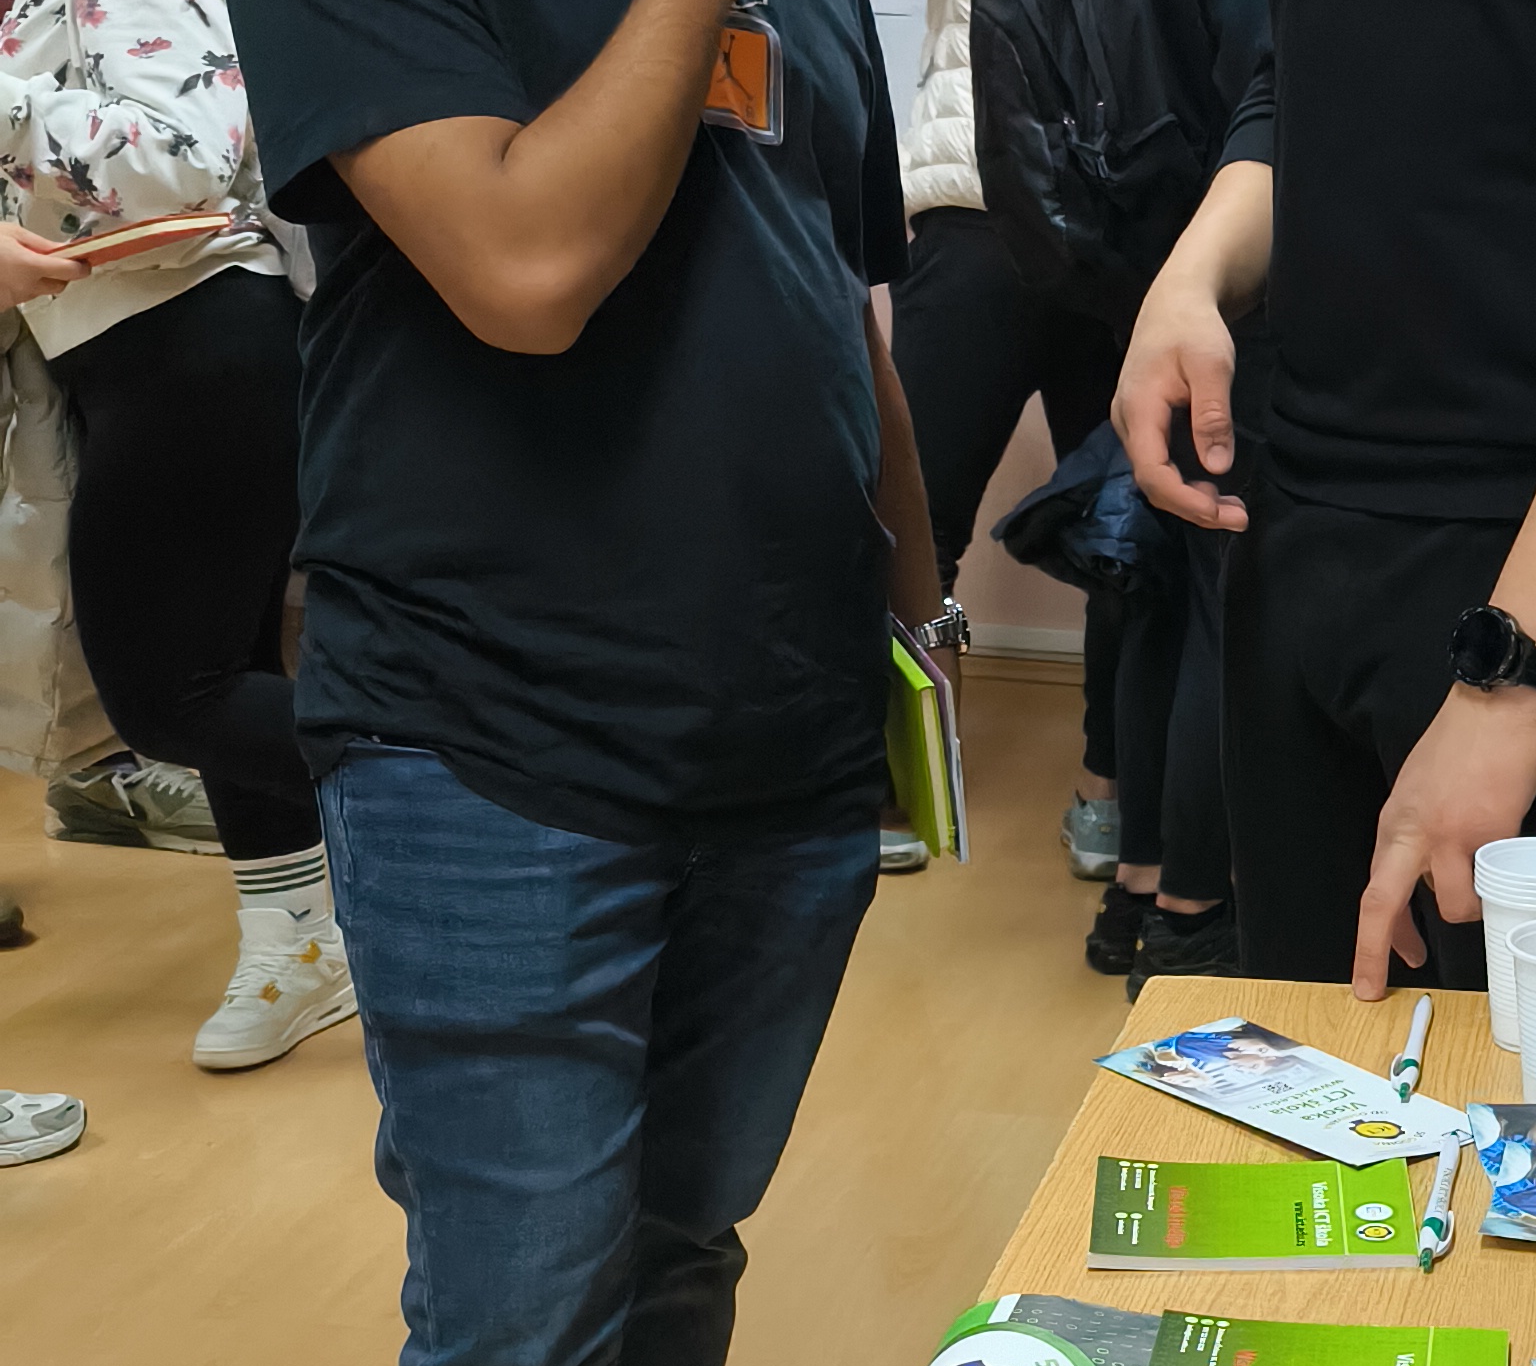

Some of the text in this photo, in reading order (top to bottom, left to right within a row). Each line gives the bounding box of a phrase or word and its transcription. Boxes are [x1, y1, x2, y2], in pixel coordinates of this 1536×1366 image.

[1269, 1088, 1355, 1116] ICT škola
[1300, 1102, 1367, 1122] Visoka
